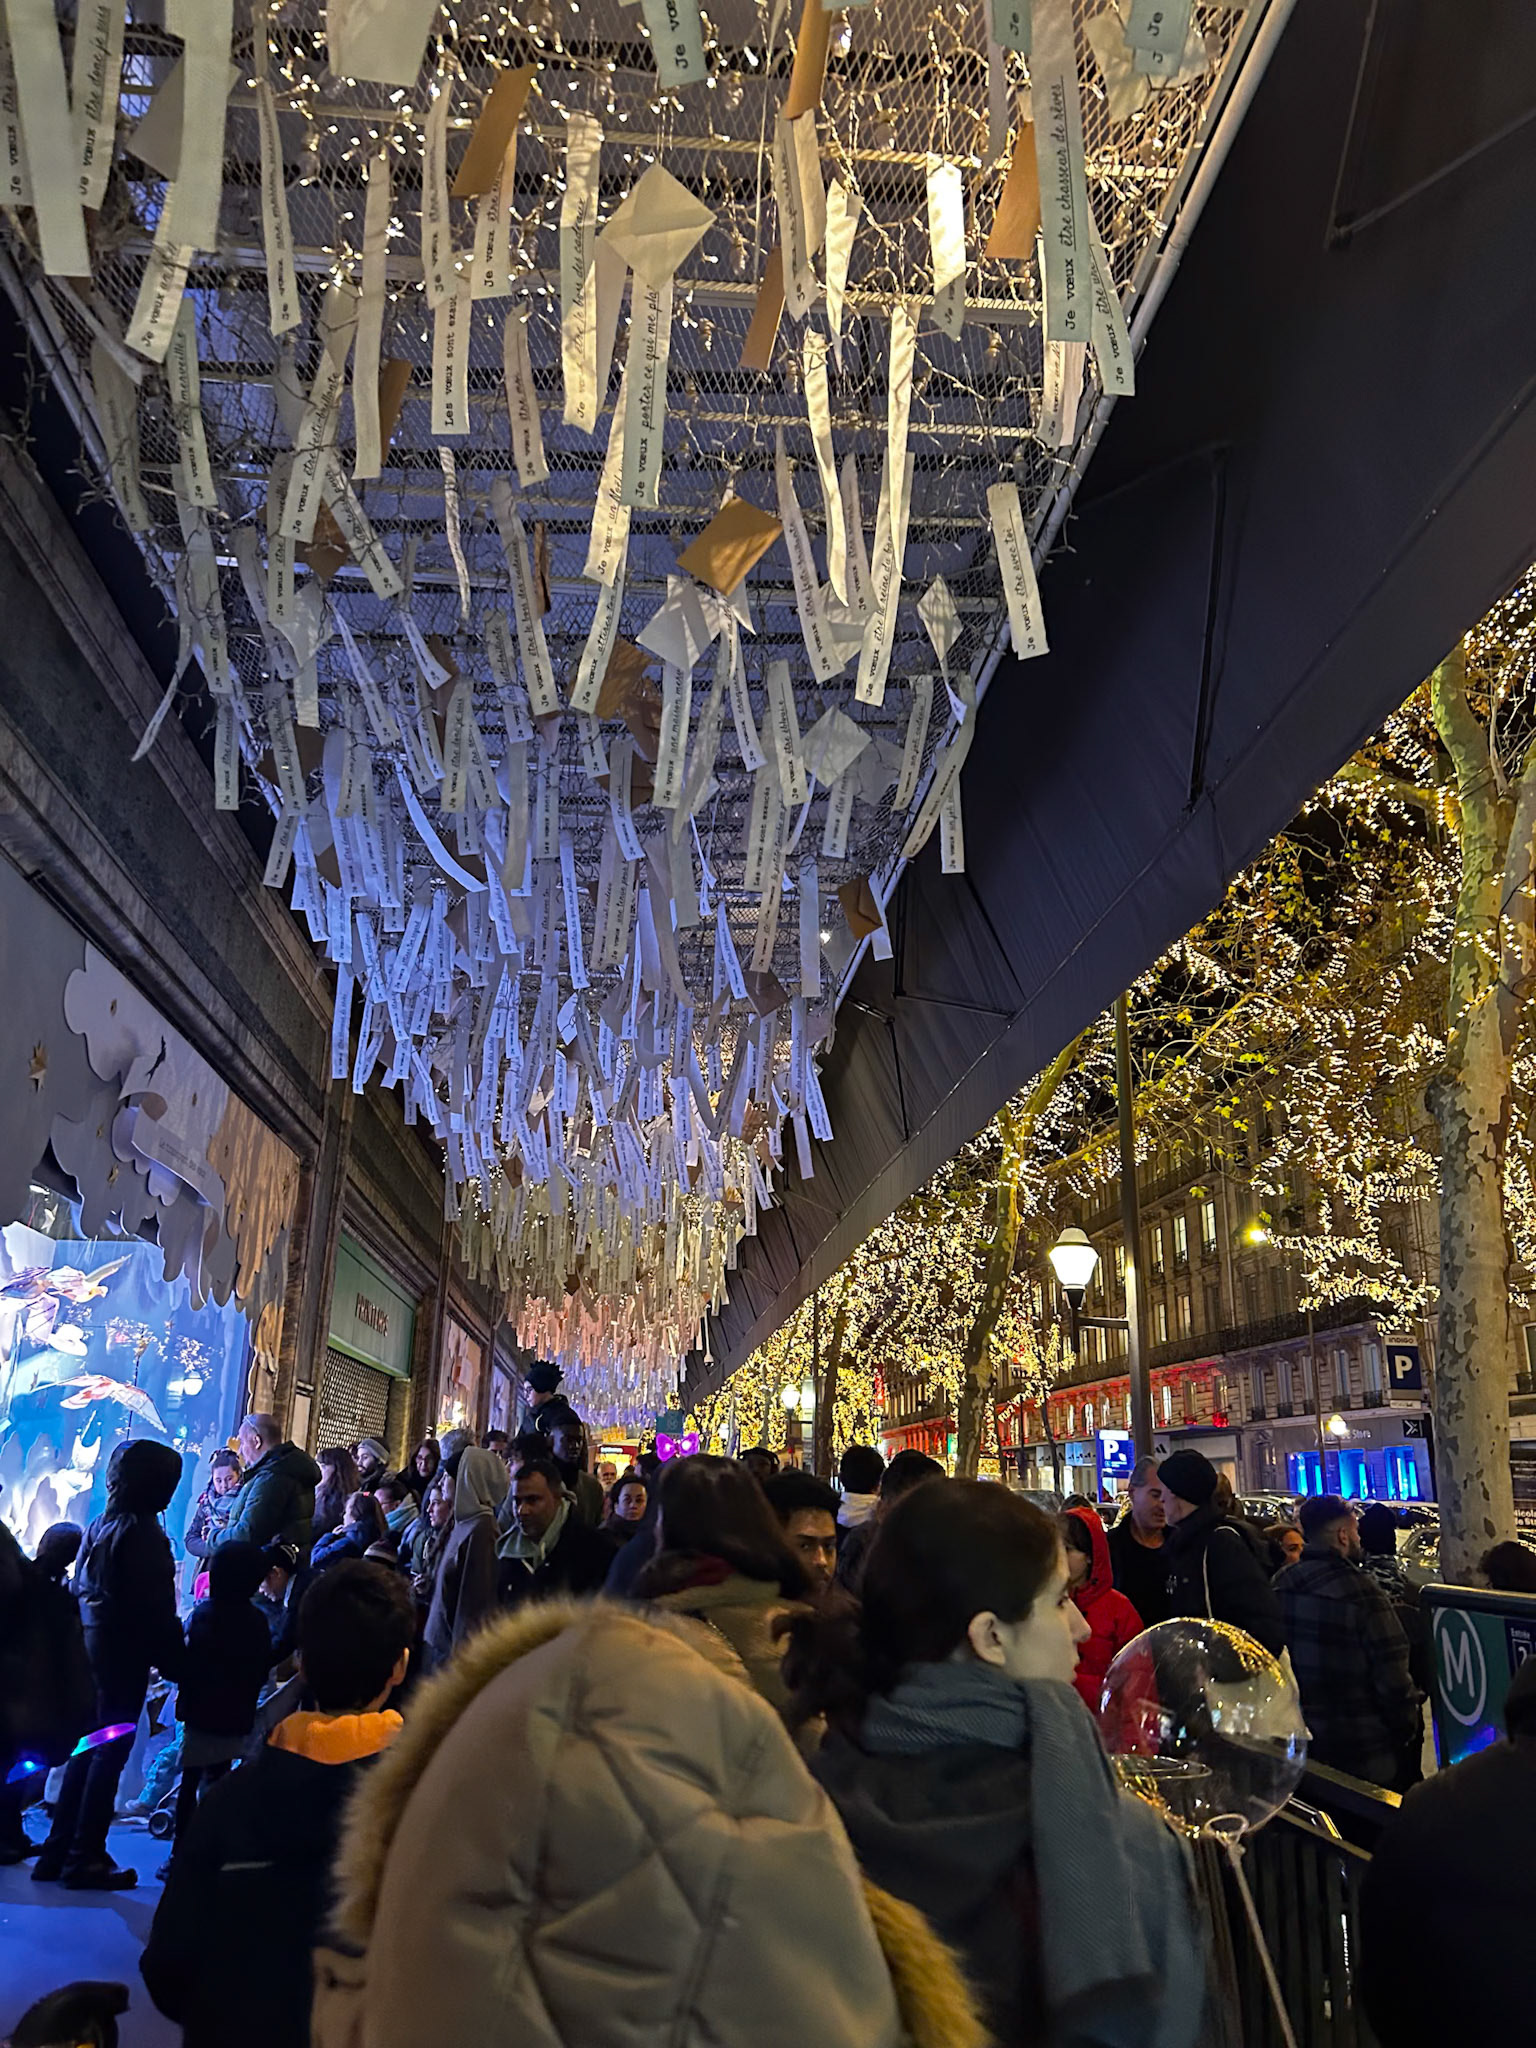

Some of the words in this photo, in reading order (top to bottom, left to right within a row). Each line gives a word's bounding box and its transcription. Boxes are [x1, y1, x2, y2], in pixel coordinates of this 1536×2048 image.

[1009, 12, 1020, 36] Je
[1147, 11, 1164, 37] Je
[675, 44, 689, 69] Je
[1050, 84, 1065, 120] rêves
[1050, 124, 1065, 141] de
[7, 125, 18, 166] vœux
[81, 127, 97, 166] vœux
[9, 176, 22, 196] Je
[79, 176, 89, 196] Je
[1055, 146, 1072, 211] chasseur
[1060, 215, 1073, 247] être
[486, 230, 495, 262] vœux
[484, 270, 494, 288] Je
[572, 258, 583, 278] des
[1064, 258, 1074, 300] vœux
[446, 294, 458, 327] exauc
[1094, 288, 1109, 315] être
[142, 331, 154, 347] Je
[150, 293, 165, 324] vœux
[573, 311, 585, 323] le
[646, 315, 656, 334] me
[1064, 310, 1076, 330] Je
[444, 331, 456, 358] sont
[642, 338, 660, 362] qui
[1105, 323, 1121, 358] vœux
[444, 365, 453, 395] vœux
[643, 365, 653, 380] ce
[1115, 367, 1125, 384] Je
[444, 403, 455, 426] Les
[576, 402, 585, 419] Je
[639, 382, 656, 430] porter
[188, 447, 198, 478] vœux
[303, 453, 316, 477] être
[637, 438, 648, 472] vœux
[527, 462, 536, 477] Je
[194, 485, 203, 499] Je
[297, 483, 310, 513] vœux
[635, 481, 646, 498] Je
[607, 505, 617, 520] un
[292, 520, 302, 534] Je
[602, 526, 613, 553] vœux
[598, 560, 607, 575] Je
[851, 565, 861, 593] vœux
[276, 571, 284, 598] vœux
[382, 577, 393, 589] Je
[276, 604, 284, 616] Je
[858, 597, 867, 611] Je
[1020, 603, 1031, 631] vœux
[811, 623, 823, 653] vœux
[874, 619, 884, 642] être
[1027, 636, 1036, 650] Je
[585, 659, 599, 686] vœux
[821, 657, 831, 671] Je
[869, 648, 880, 677] vœux
[533, 663, 544, 689] vœux
[539, 694, 549, 707] Je
[581, 691, 592, 704] Je
[865, 683, 874, 697] Je
[741, 720, 750, 746] vœux
[591, 760, 600, 772] Je
[749, 751, 757, 763] Je
[665, 760, 674, 785] vœux
[787, 760, 796, 784] vœux
[224, 795, 230, 805] Je
[448, 797, 457, 809] Je
[663, 790, 671, 802] Je
[791, 788, 799, 799] Je
[755, 846, 763, 868] vœux
[752, 871, 762, 887] Les
[1394, 1355, 1413, 1380] P
[1103, 1440, 1120, 1460] P
[1441, 1627, 1475, 1698] M
